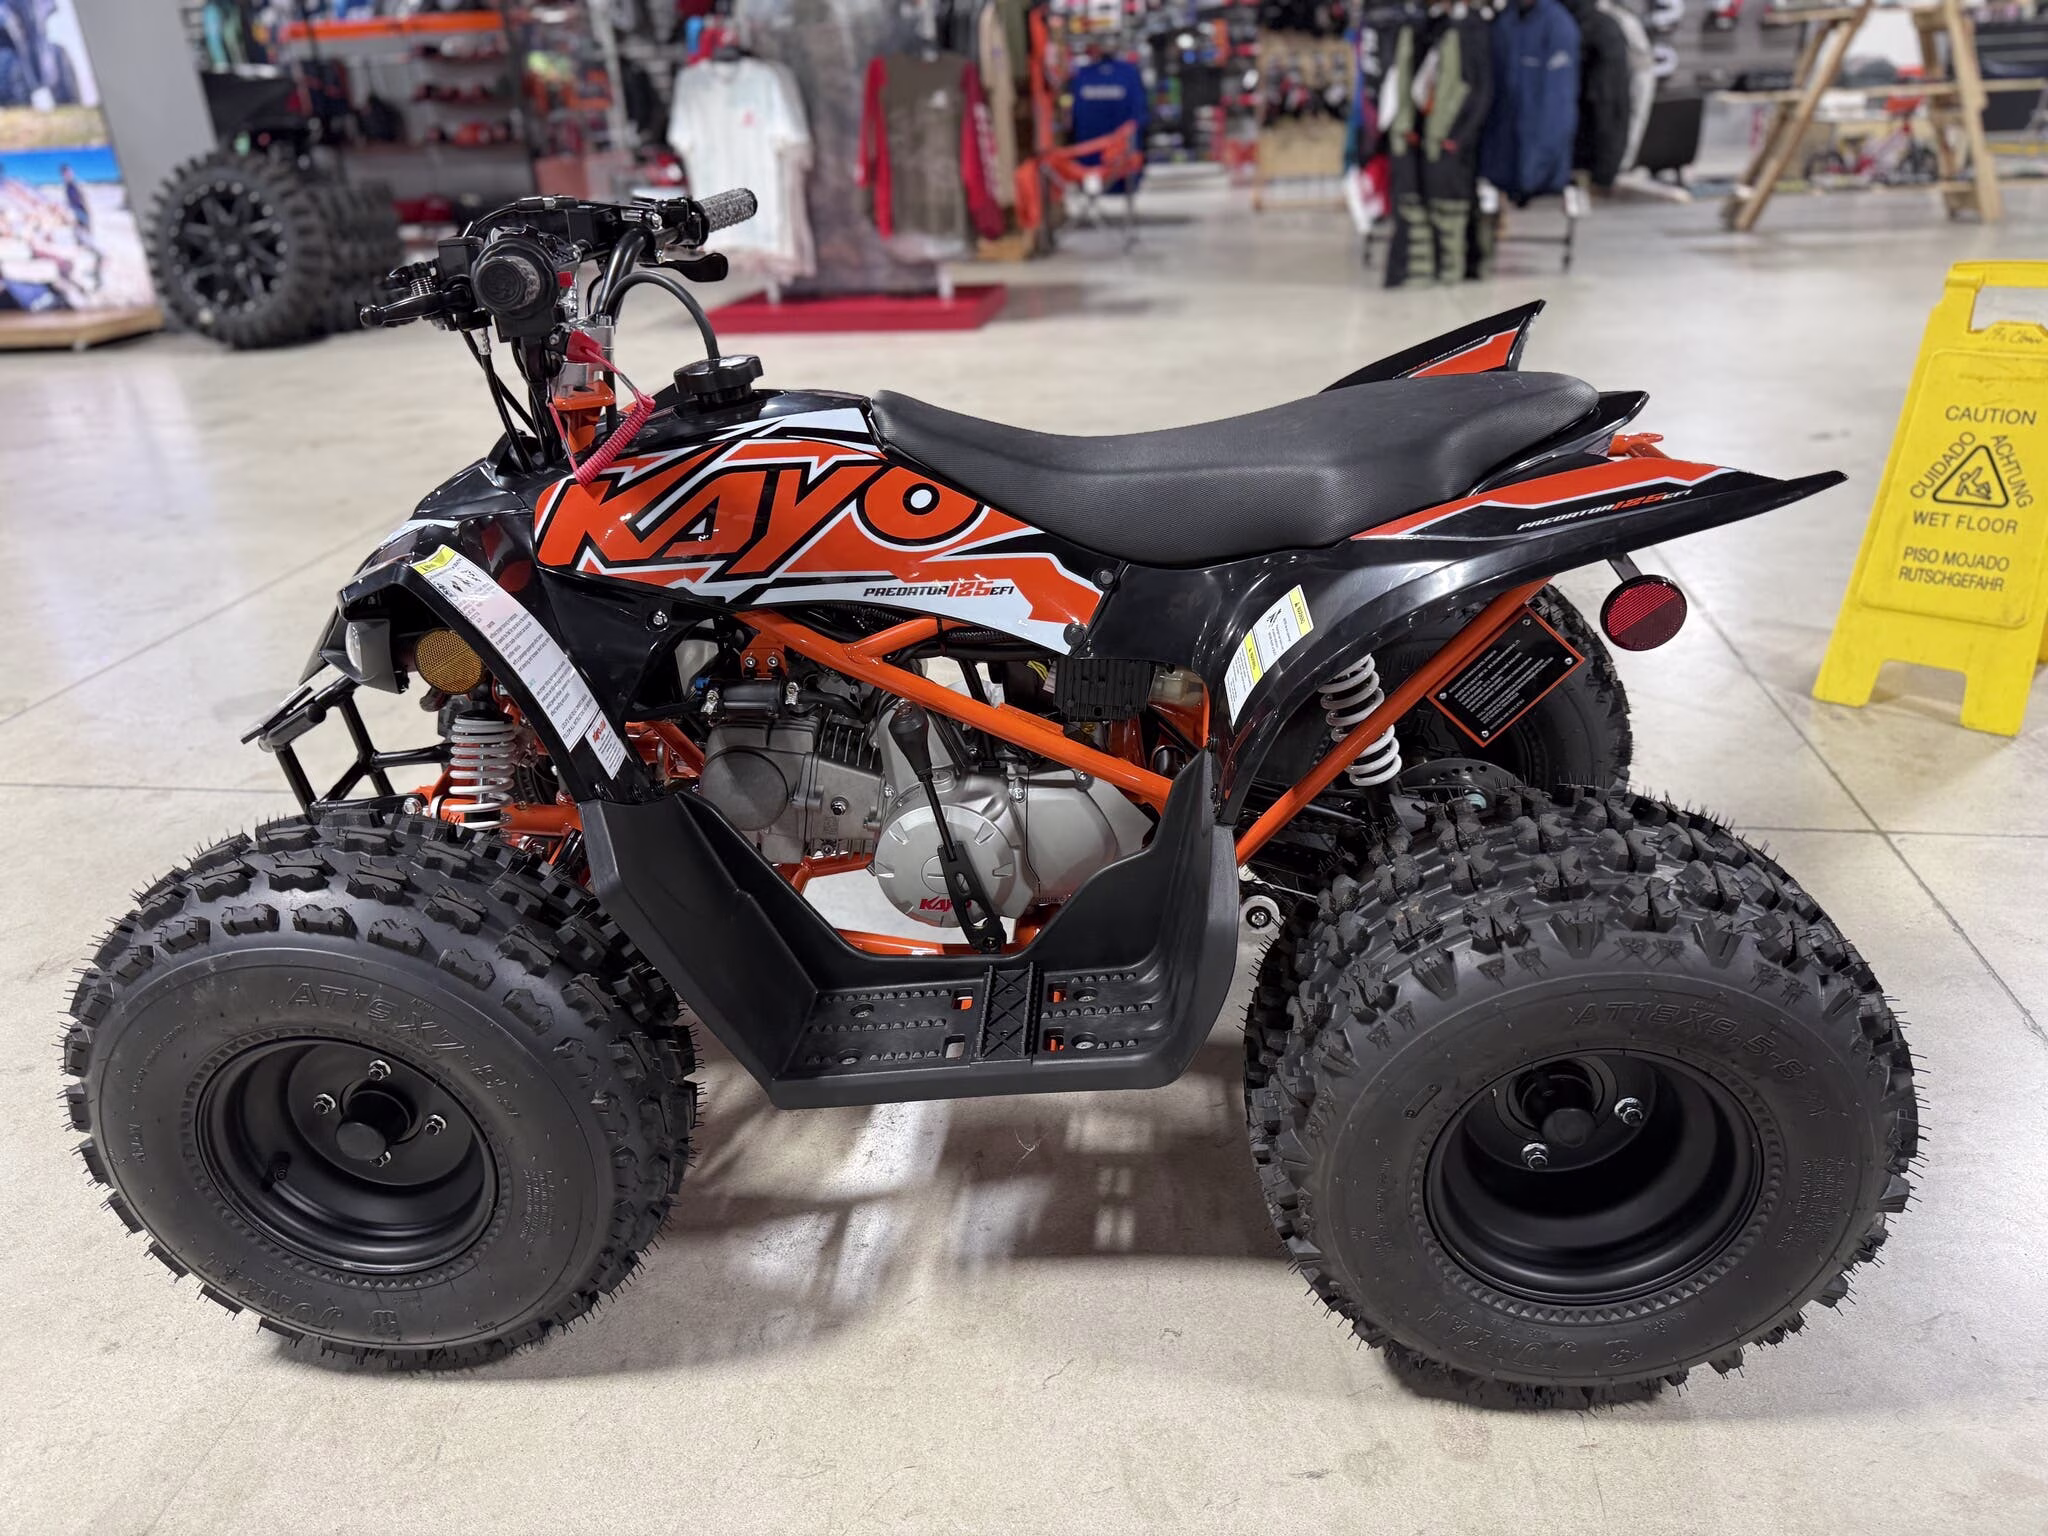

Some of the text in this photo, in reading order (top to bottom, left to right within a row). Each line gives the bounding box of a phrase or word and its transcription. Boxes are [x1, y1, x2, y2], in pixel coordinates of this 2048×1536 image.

[1945, 404, 2037, 426] CAUTION
[1910, 431, 1976, 498] CUIDADO
[1990, 434, 2034, 508] ACHTUNG
[535, 438, 986, 577] KAYO
[1912, 510, 2018, 534] WET FLOOR
[1903, 546, 2010, 572] PISO MOJADO
[1898, 565, 2005, 591] RUTSCHGEFAHR
